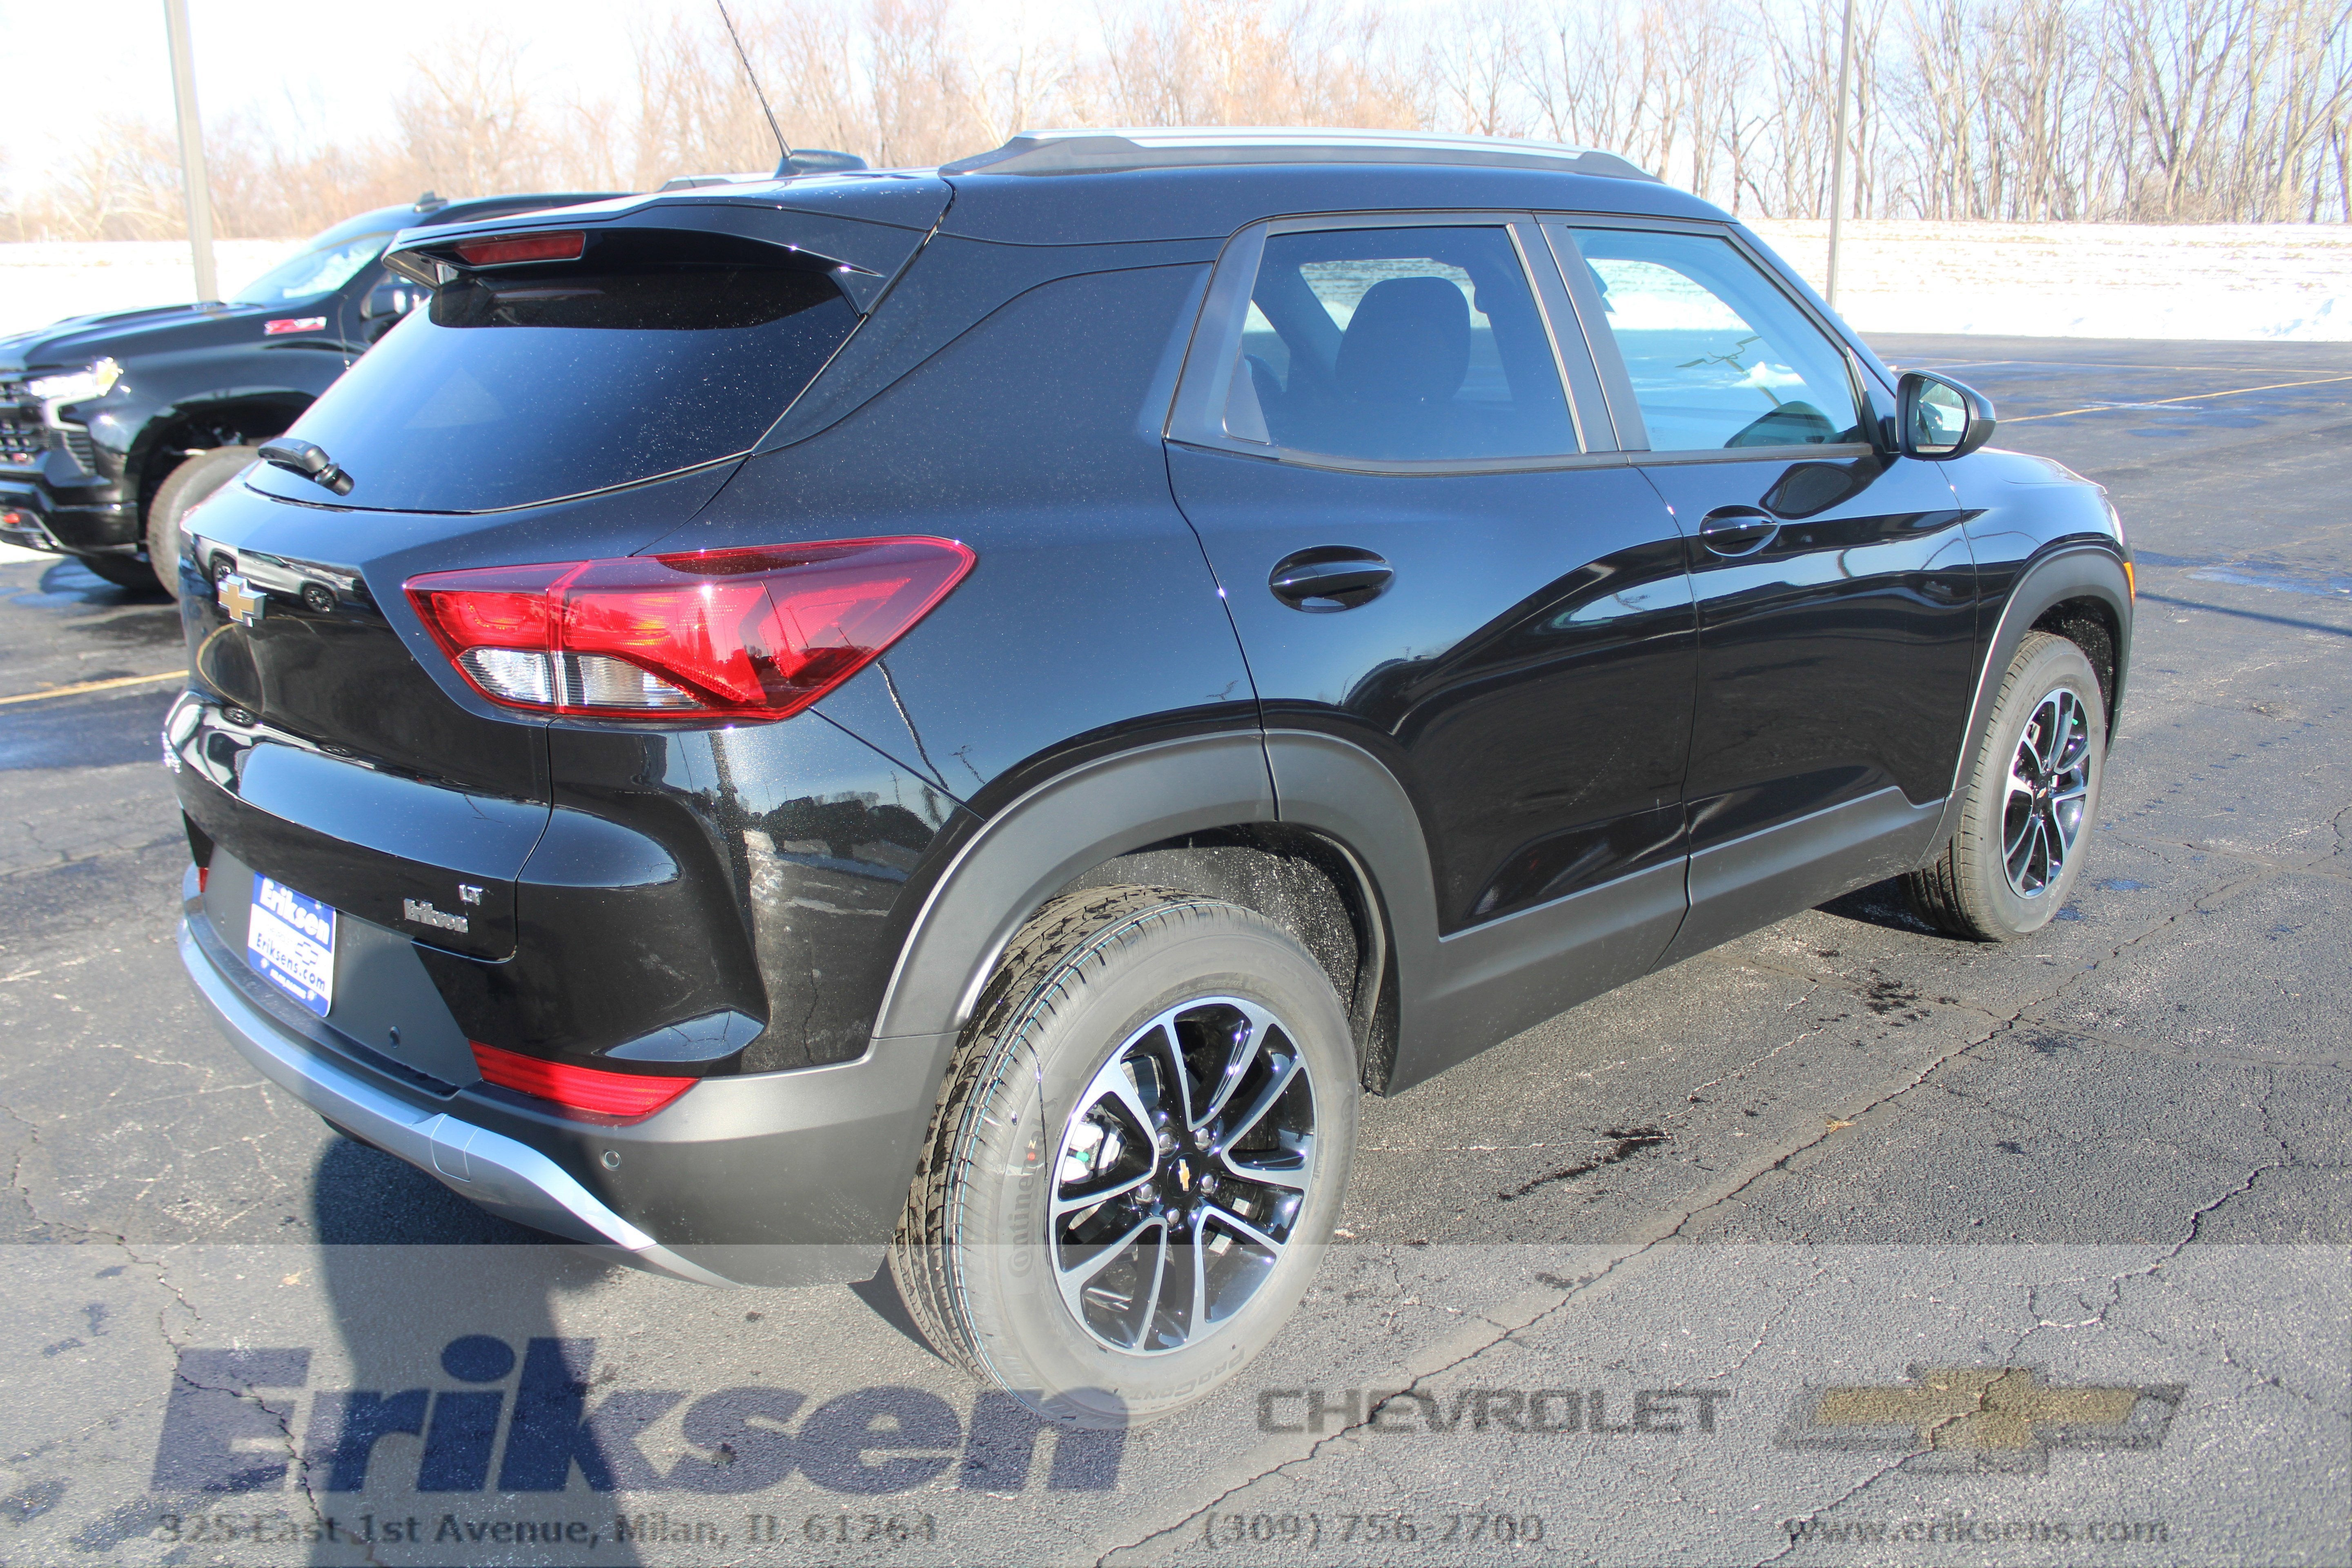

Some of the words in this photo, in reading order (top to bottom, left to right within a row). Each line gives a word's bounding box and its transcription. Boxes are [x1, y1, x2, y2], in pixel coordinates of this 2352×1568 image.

[260, 877, 330, 945] Eriksen
[403, 898, 469, 933] Eriksen
[256, 932, 325, 992] Eriksens.com
